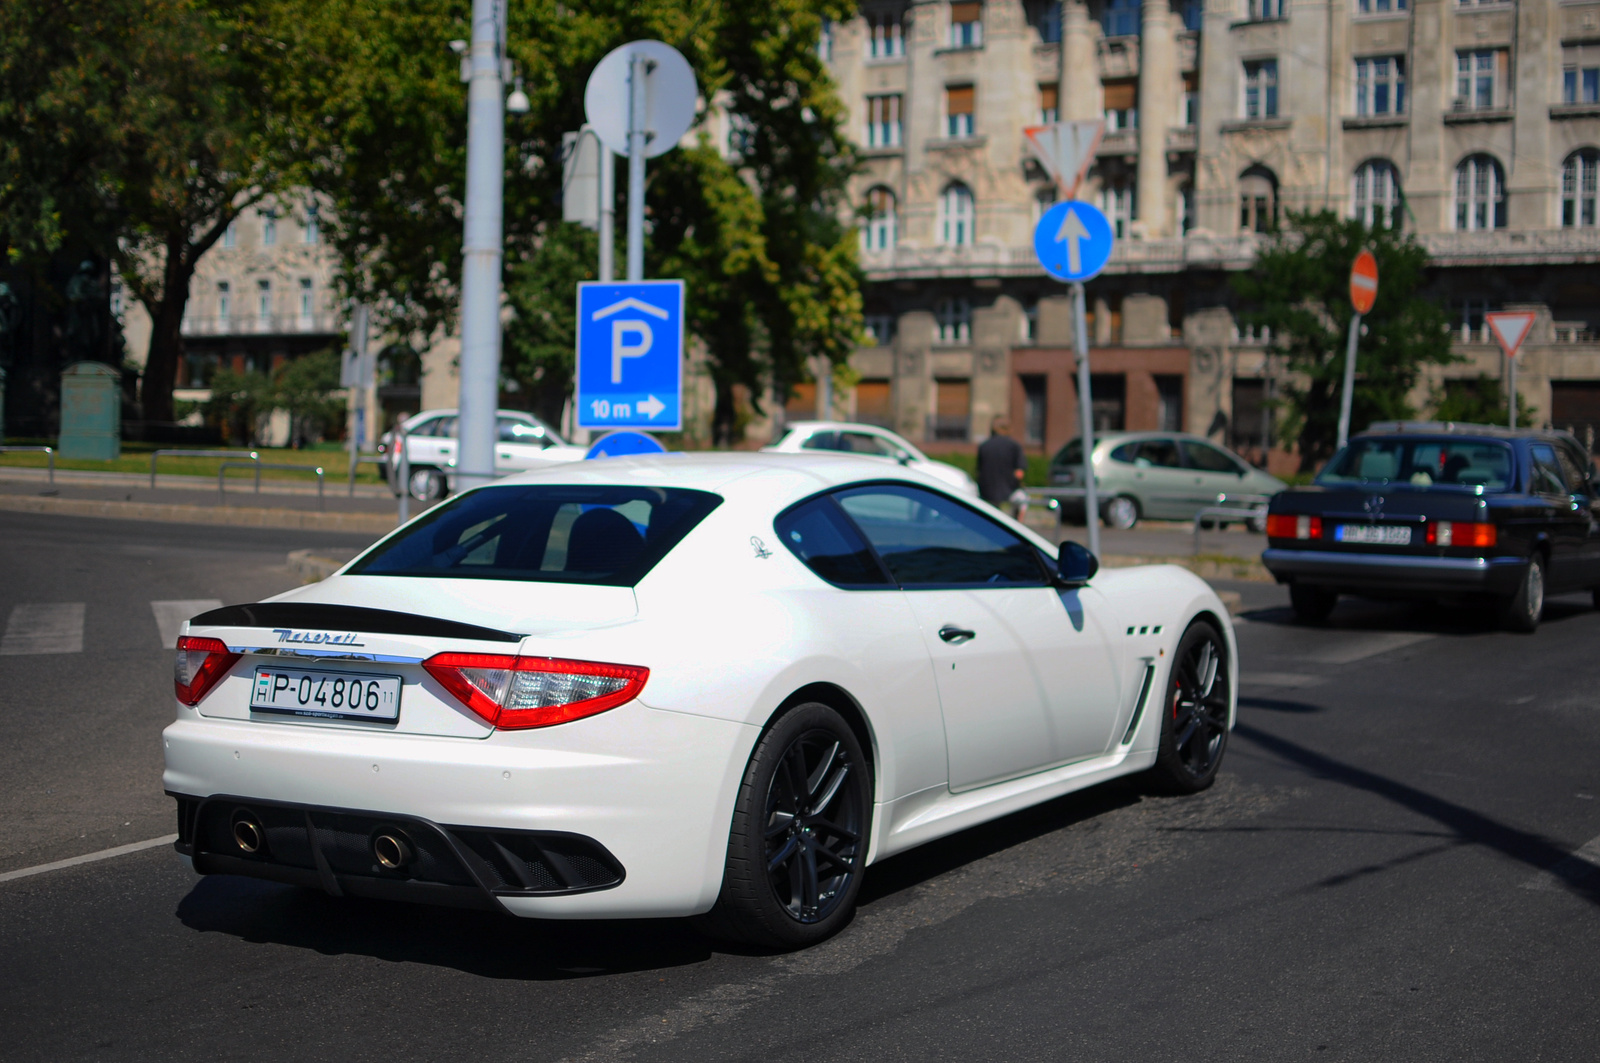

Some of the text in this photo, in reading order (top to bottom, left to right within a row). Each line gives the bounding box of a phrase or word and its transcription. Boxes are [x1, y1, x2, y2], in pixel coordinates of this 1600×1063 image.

[611, 319, 653, 384] P
[591, 399, 631, 418] 10 m
[272, 628, 364, 646] Maserati
[256, 688, 267, 702] H
[272, 673, 380, 711] P-04806
